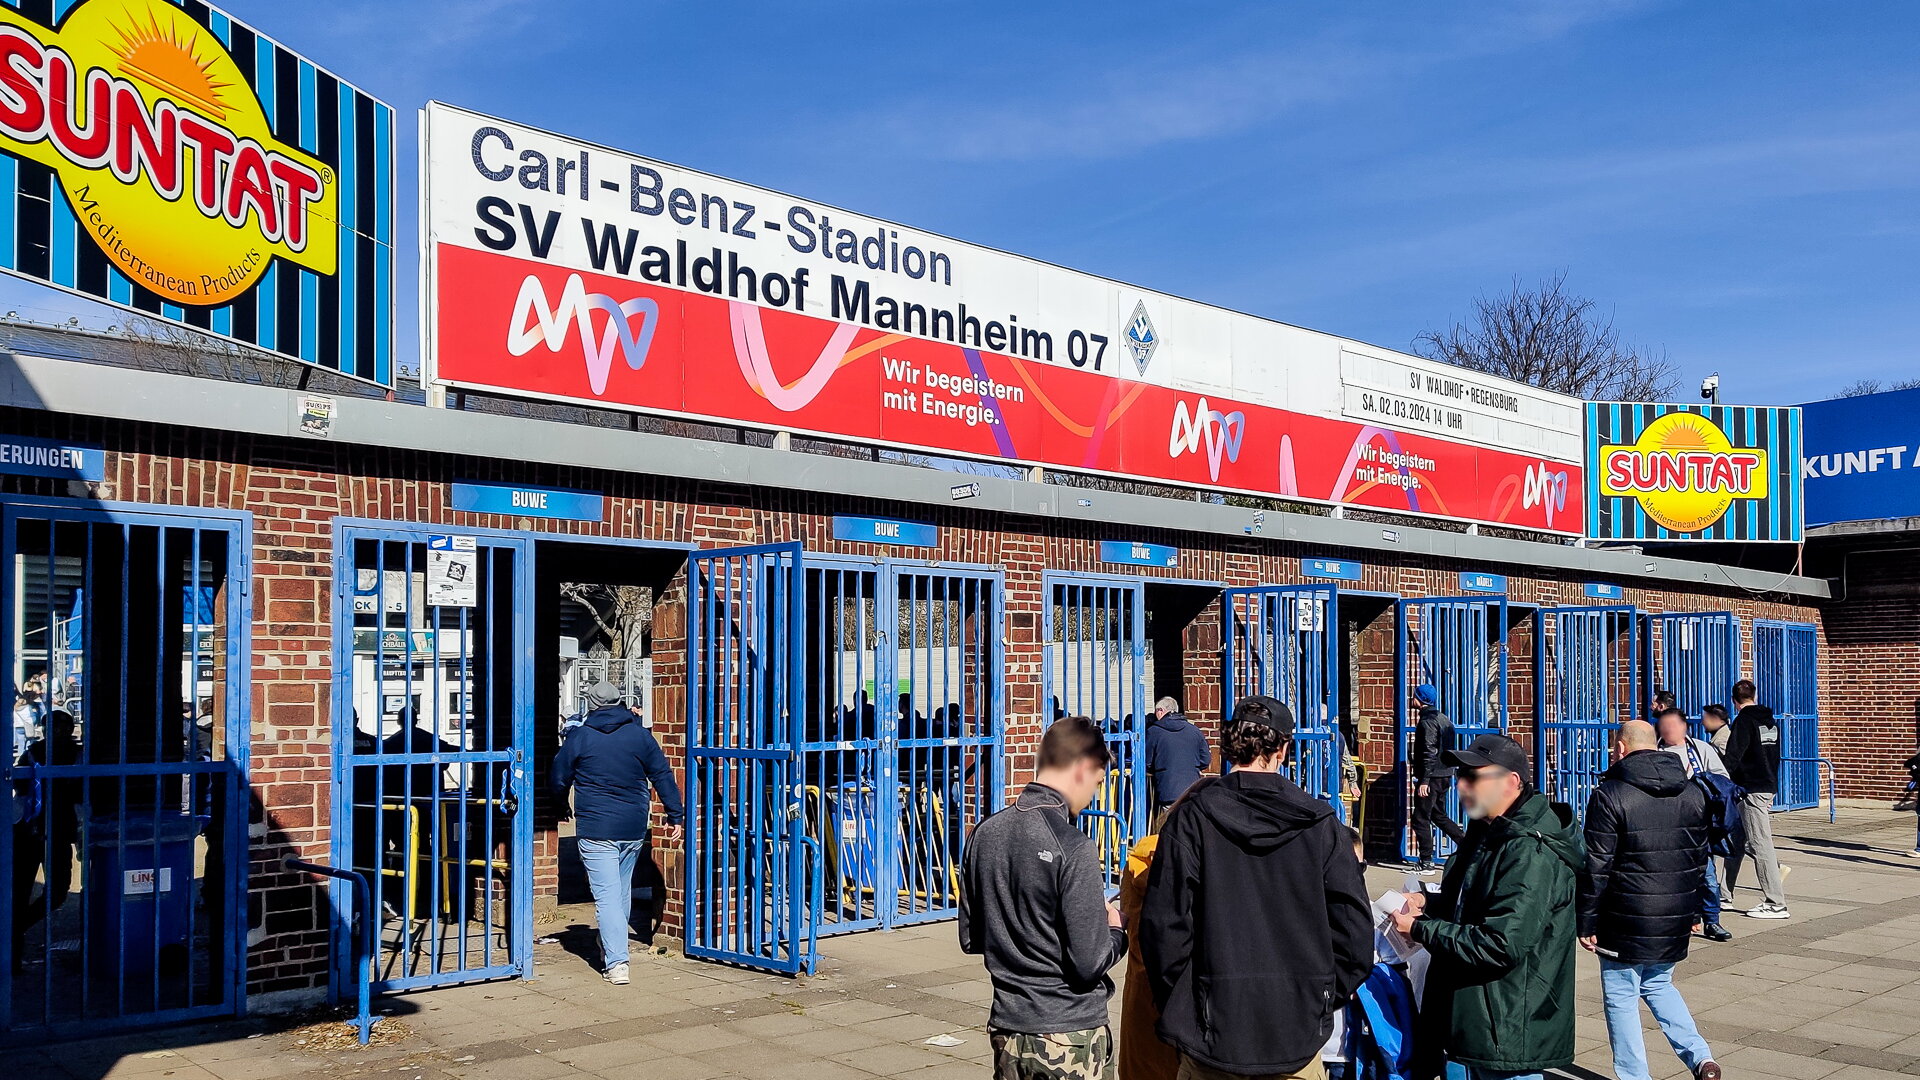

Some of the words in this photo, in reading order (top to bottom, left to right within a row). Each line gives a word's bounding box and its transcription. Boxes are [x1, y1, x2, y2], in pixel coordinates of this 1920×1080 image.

[0, 26, 323, 252] SUNTAT
[74, 184, 198, 296] Mediterranean
[200, 247, 261, 296] Products
[473, 195, 562, 260] SV
[580, 216, 810, 313] Waldhof
[830, 273, 1053, 363] Mannheim
[1066, 328, 1109, 372] 07
[882, 356, 921, 385] Wir
[925, 364, 1024, 403] begeistern
[1410, 372, 1421, 390] SV
[1426, 376, 1464, 400] WALDHOF
[1470, 387, 1518, 412] REGENSBURG
[883, 388, 917, 412] mit
[922, 391, 1000, 427] Energie.
[1362, 393, 1377, 412] SA.
[1379, 396, 1430, 423] 02.03.2024
[1433, 409, 1442, 426] 14
[1447, 411, 1462, 430] UHR
[0, 443, 84, 470] ERUNGEN
[1355, 442, 1377, 462] Wir
[1379, 446, 1436, 472] begeistern
[1607, 450, 1760, 493] SUNTAT
[1801, 445, 1907, 479] KUNFT
[1356, 465, 1375, 482] mit
[1377, 467, 1422, 491] Energie.
[512, 490, 548, 509] BUWE
[1643, 497, 1697, 528] Mediterranean
[1697, 497, 1728, 526] Products
[874, 521, 900, 538] BUWE
[1131, 546, 1151, 560] BUWE
[1325, 562, 1341, 574] BUWE
